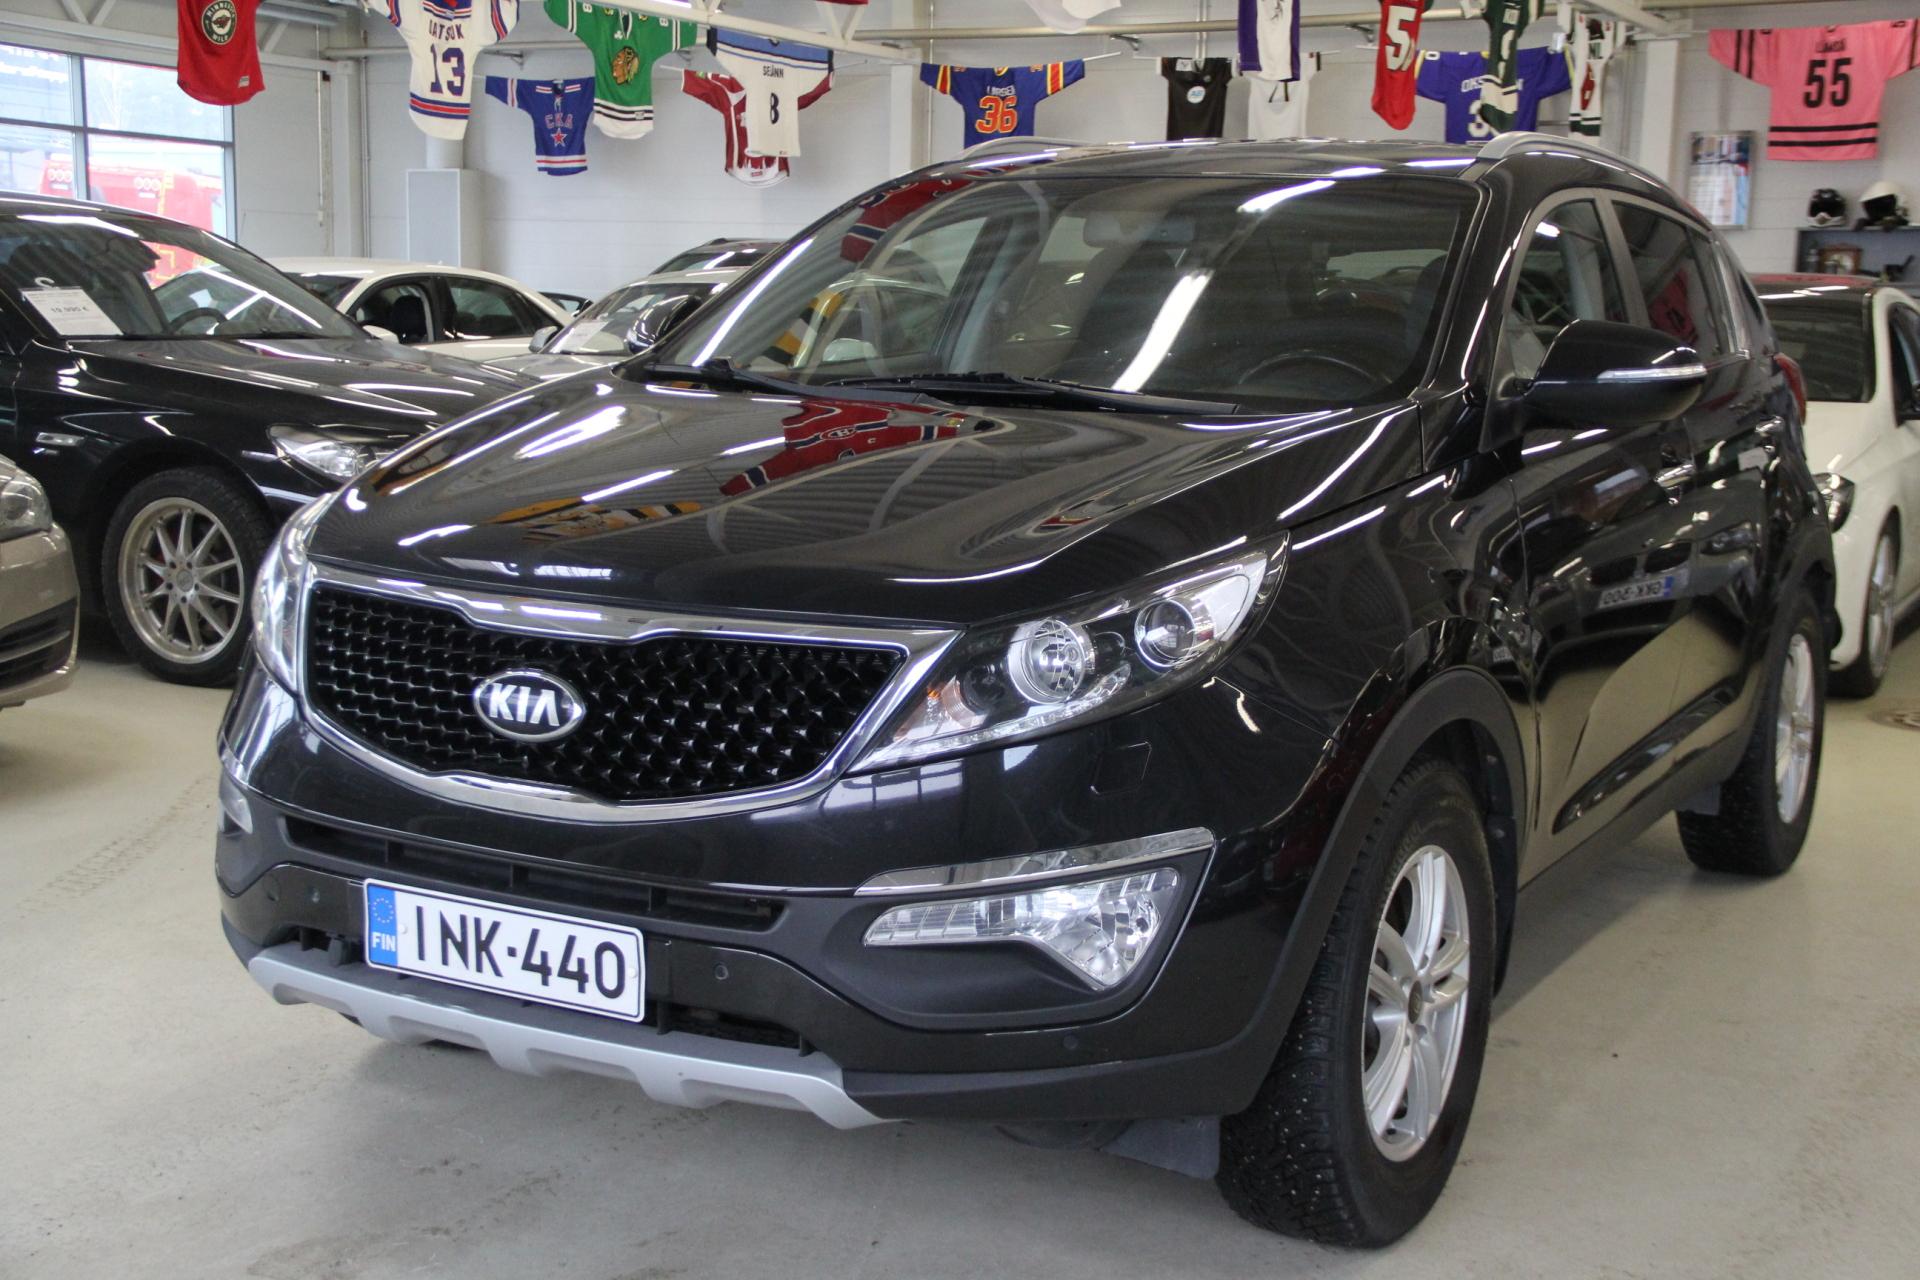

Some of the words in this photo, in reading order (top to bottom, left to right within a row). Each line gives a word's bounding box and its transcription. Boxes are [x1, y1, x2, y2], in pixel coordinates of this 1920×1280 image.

[430, 43, 465, 97] 13
[1803, 57, 1853, 108] 55
[770, 92, 779, 124] 8
[975, 95, 1018, 134] 36
[489, 682, 560, 727] KIA
[371, 931, 396, 953] FIN
[415, 905, 626, 1000] INK-440
